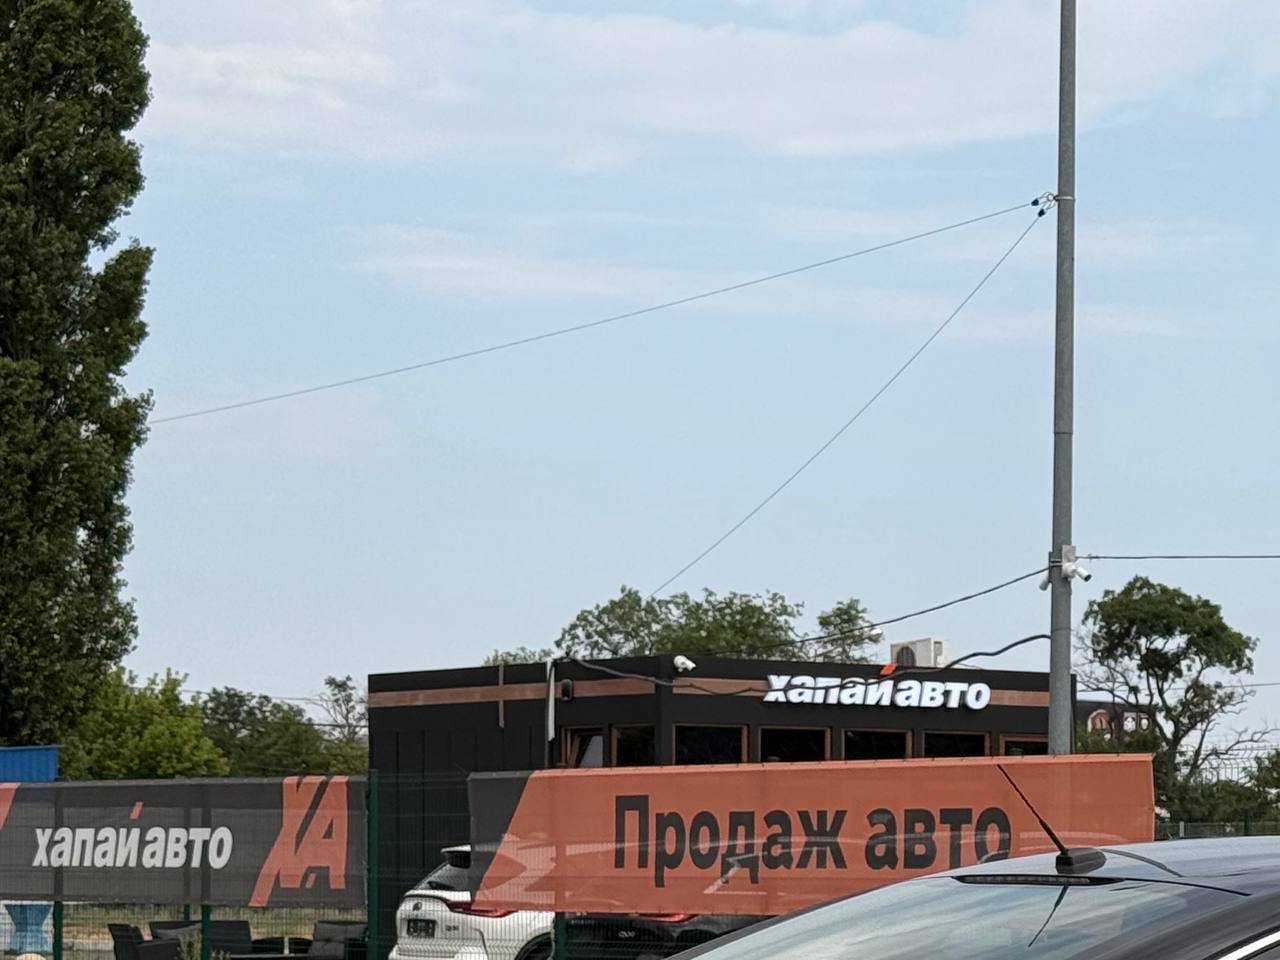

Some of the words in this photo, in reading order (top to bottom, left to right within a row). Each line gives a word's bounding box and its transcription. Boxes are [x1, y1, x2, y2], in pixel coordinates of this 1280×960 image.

[895, 680, 991, 710] авто
[142, 826, 233, 870] авто
[614, 795, 848, 888] Продаж
[864, 807, 1012, 870] авто
